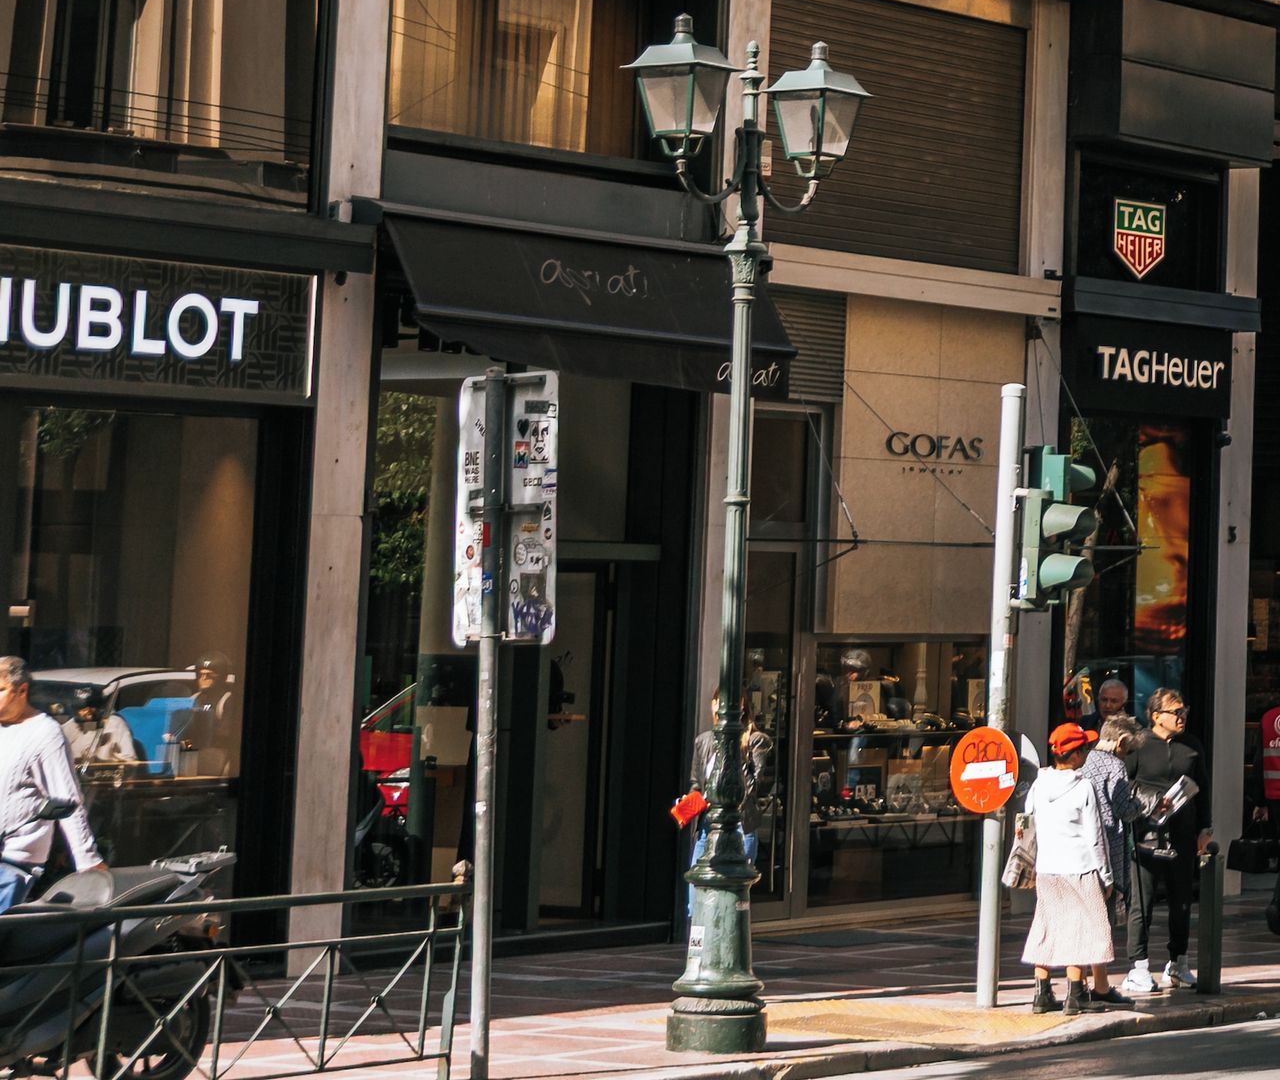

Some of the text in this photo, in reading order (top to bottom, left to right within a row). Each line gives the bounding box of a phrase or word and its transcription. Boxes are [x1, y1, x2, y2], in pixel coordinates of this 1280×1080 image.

[1120, 206, 1161, 232] TAG
[1117, 234, 1162, 271] HEUER
[465, 451, 480, 467] BNE
[885, 431, 984, 461] GOFAS
[465, 467, 479, 476] WAS
